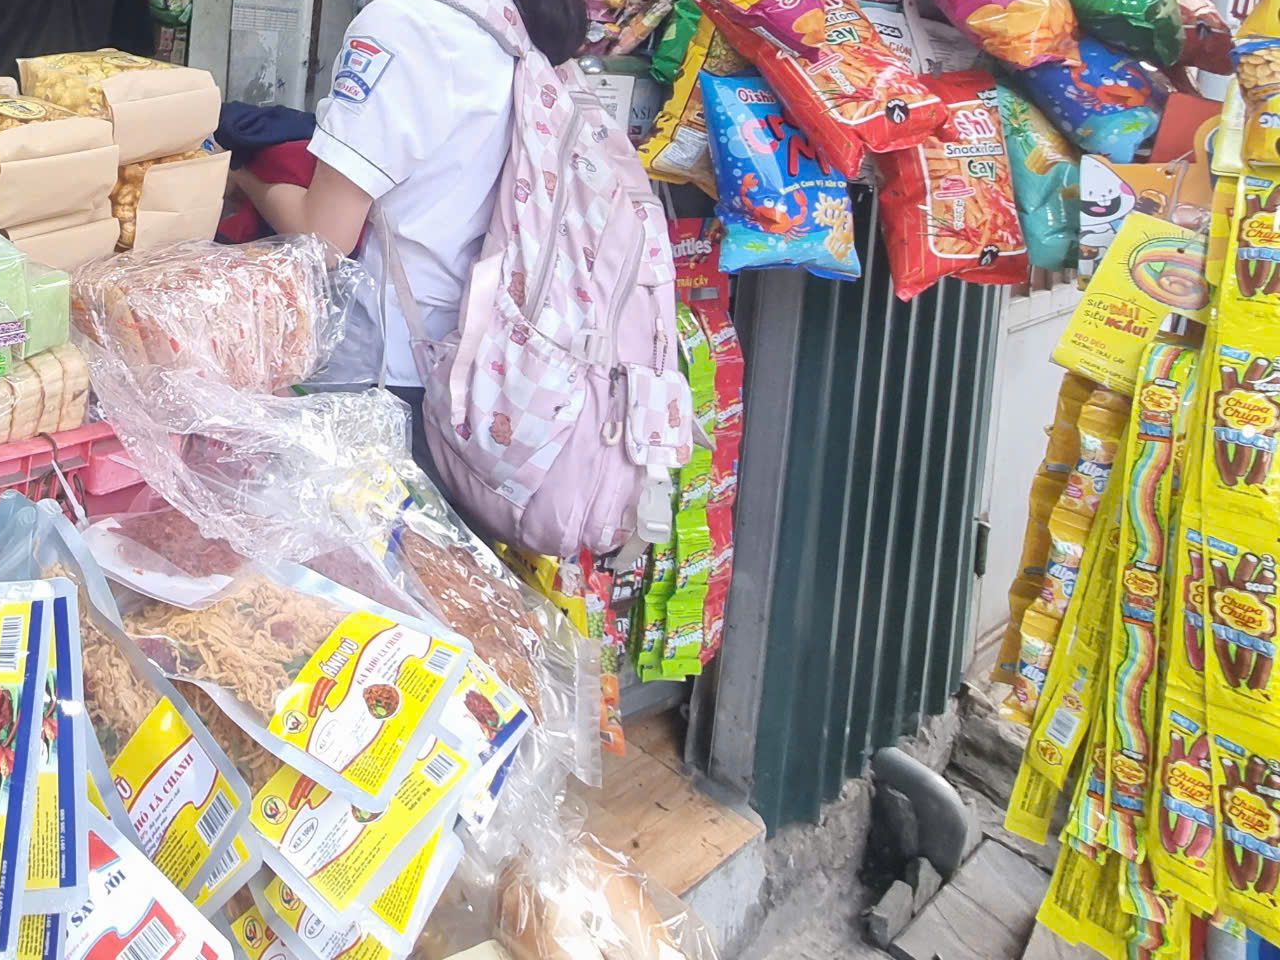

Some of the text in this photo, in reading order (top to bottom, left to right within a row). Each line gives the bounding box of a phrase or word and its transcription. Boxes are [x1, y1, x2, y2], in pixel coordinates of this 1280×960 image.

[967, 159, 997, 180] Cay
[1223, 406, 1268, 426] Chups
[1225, 396, 1272, 415] Chupa
[1078, 459, 1111, 477] Alpe
[1220, 603, 1266, 628] Chups
[1221, 593, 1265, 616] Chupa
[320, 653, 350, 679] ÁNH
[149, 792, 165, 813] LÁ
[162, 752, 195, 795] CHANH
[1168, 776, 1211, 802] Chups
[1170, 767, 1212, 790] Chupa
[1229, 805, 1270, 832] Chups
[1231, 795, 1271, 820] Chupa
